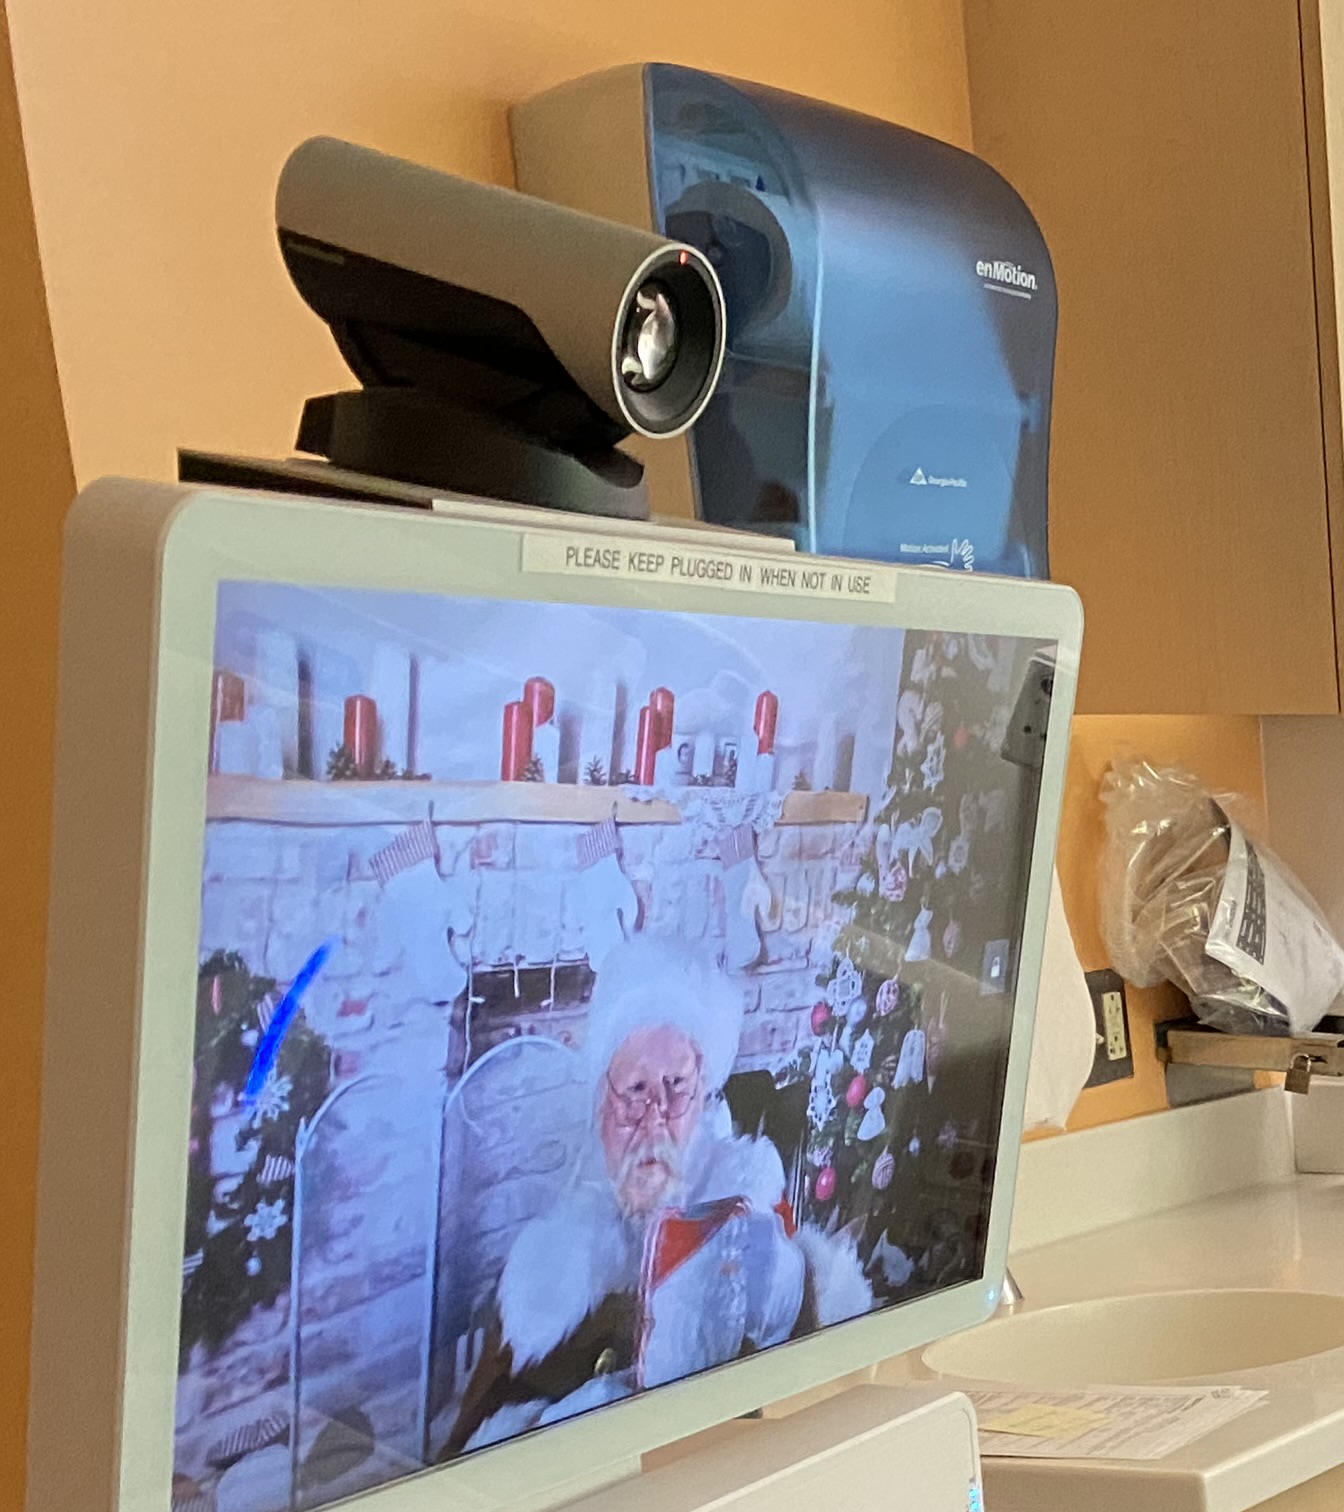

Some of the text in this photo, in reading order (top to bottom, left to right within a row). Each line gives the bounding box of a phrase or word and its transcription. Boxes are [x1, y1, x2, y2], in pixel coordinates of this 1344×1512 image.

[976, 260, 1036, 290] enMotion
[565, 546, 871, 594] PLEASE KEEP PLUGGED IN WHEN NOT IN USE
